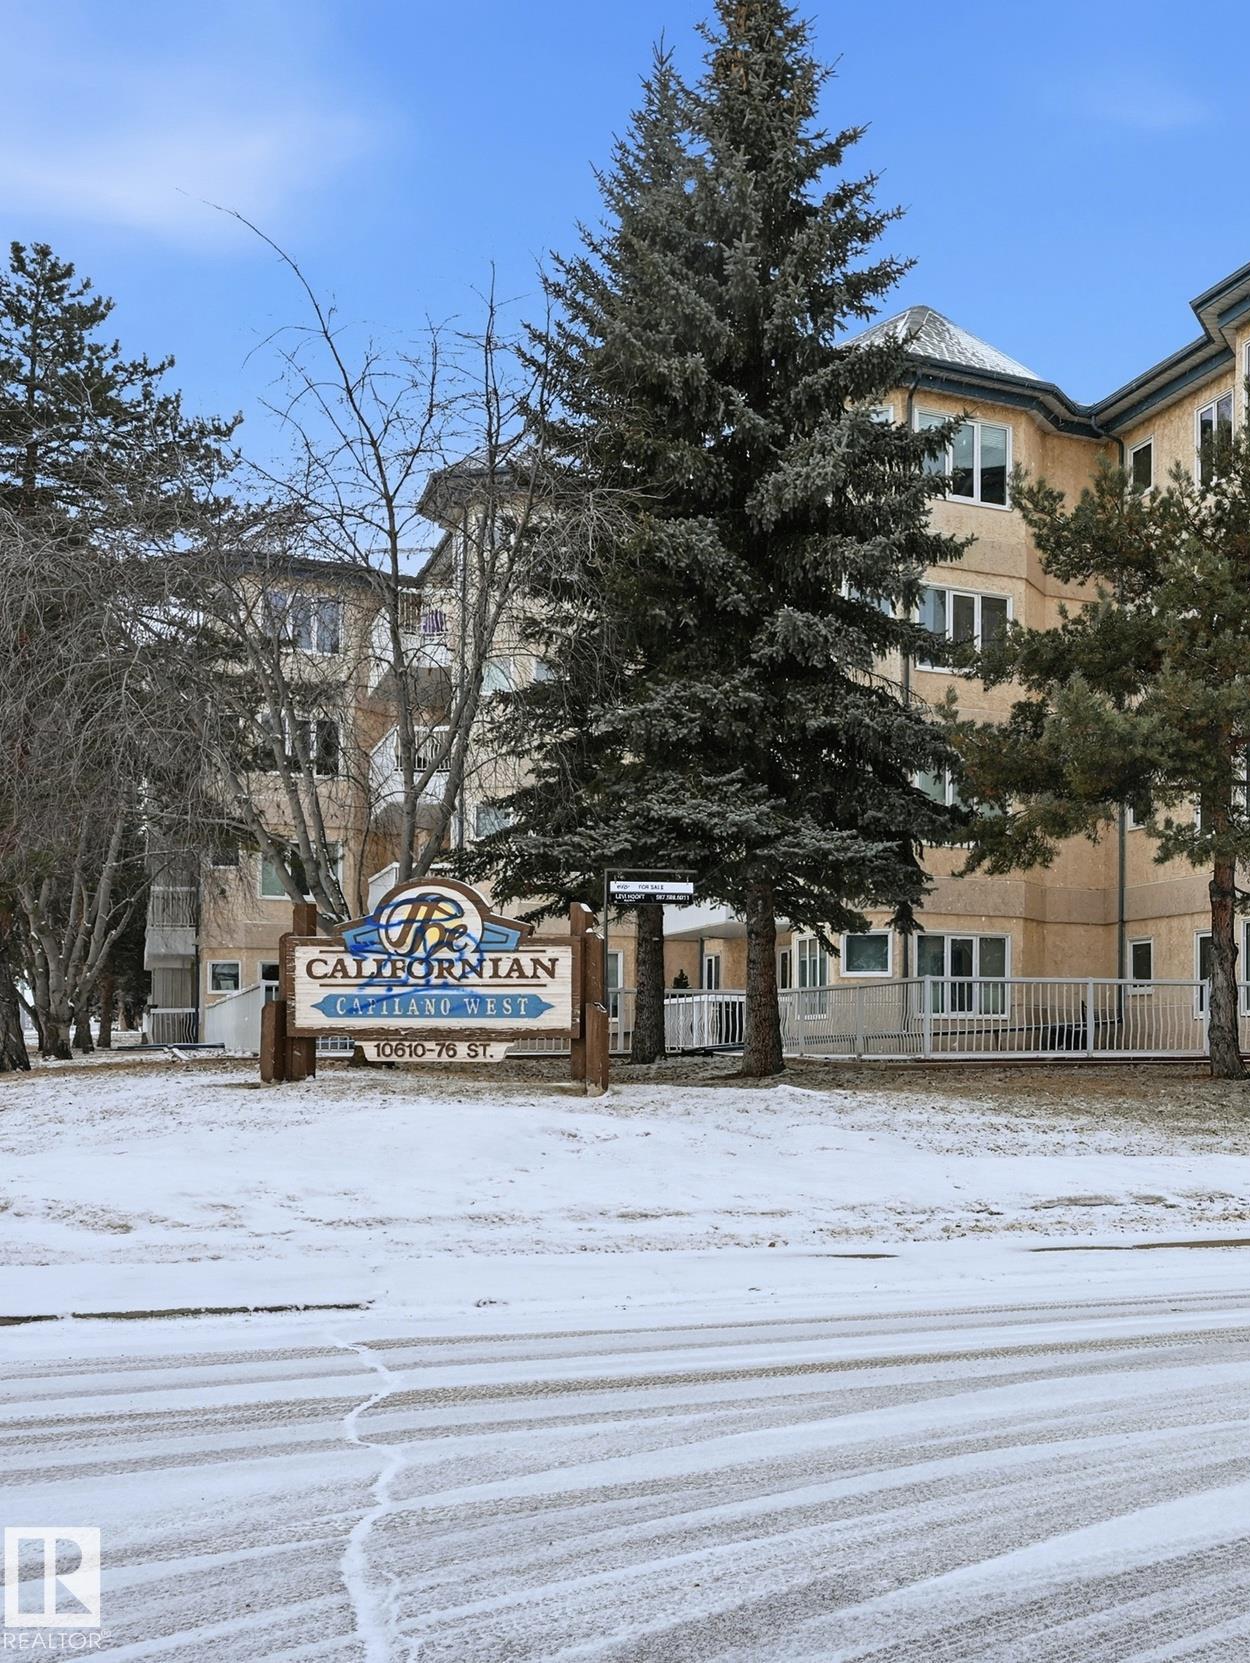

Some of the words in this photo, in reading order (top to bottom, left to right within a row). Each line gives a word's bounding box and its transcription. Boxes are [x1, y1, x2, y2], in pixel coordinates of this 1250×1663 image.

[385, 892, 469, 957] The
[305, 957, 559, 982] CALIFORNIAN
[336, 996, 452, 1017] CAPILANO
[463, 996, 529, 1016] WEST
[374, 1042, 458, 1059] 10610-76
[466, 1042, 494, 1059] ST.
